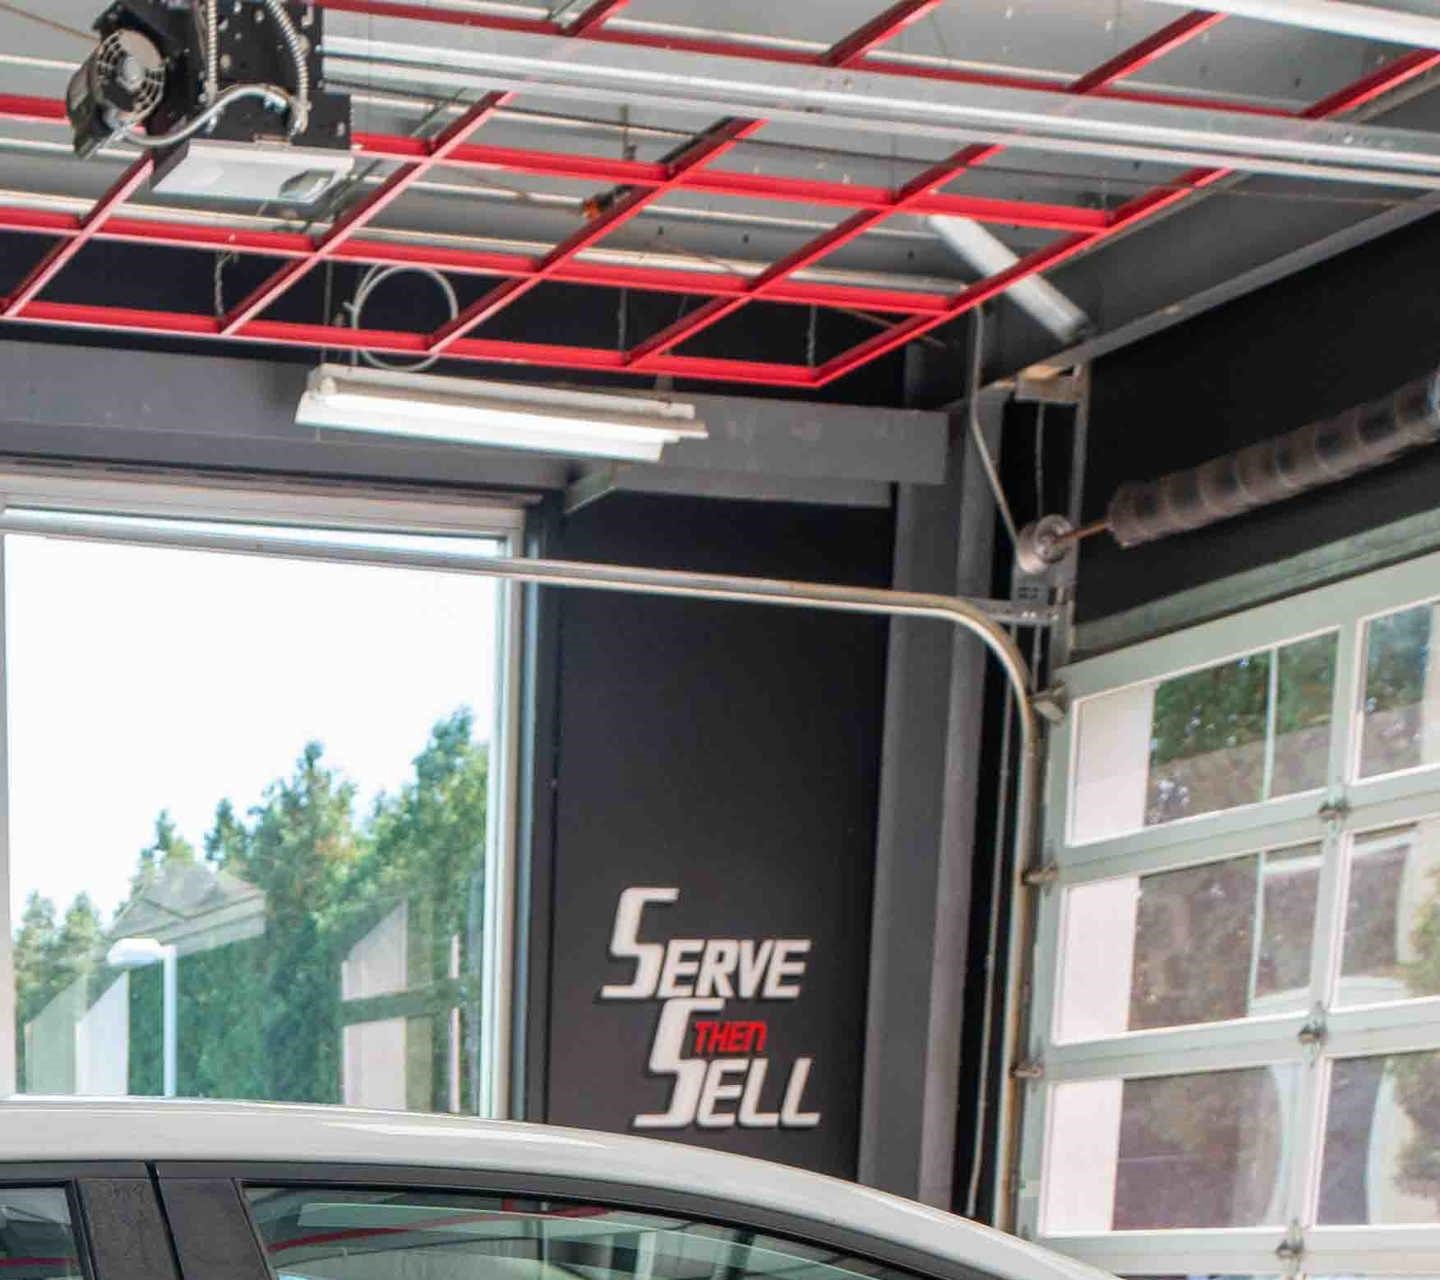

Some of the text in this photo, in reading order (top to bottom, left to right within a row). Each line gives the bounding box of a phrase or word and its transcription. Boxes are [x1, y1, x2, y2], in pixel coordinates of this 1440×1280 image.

[600, 887, 812, 999] SERVE
[633, 997, 821, 1128] SELL
[693, 1020, 768, 1053] THEN
